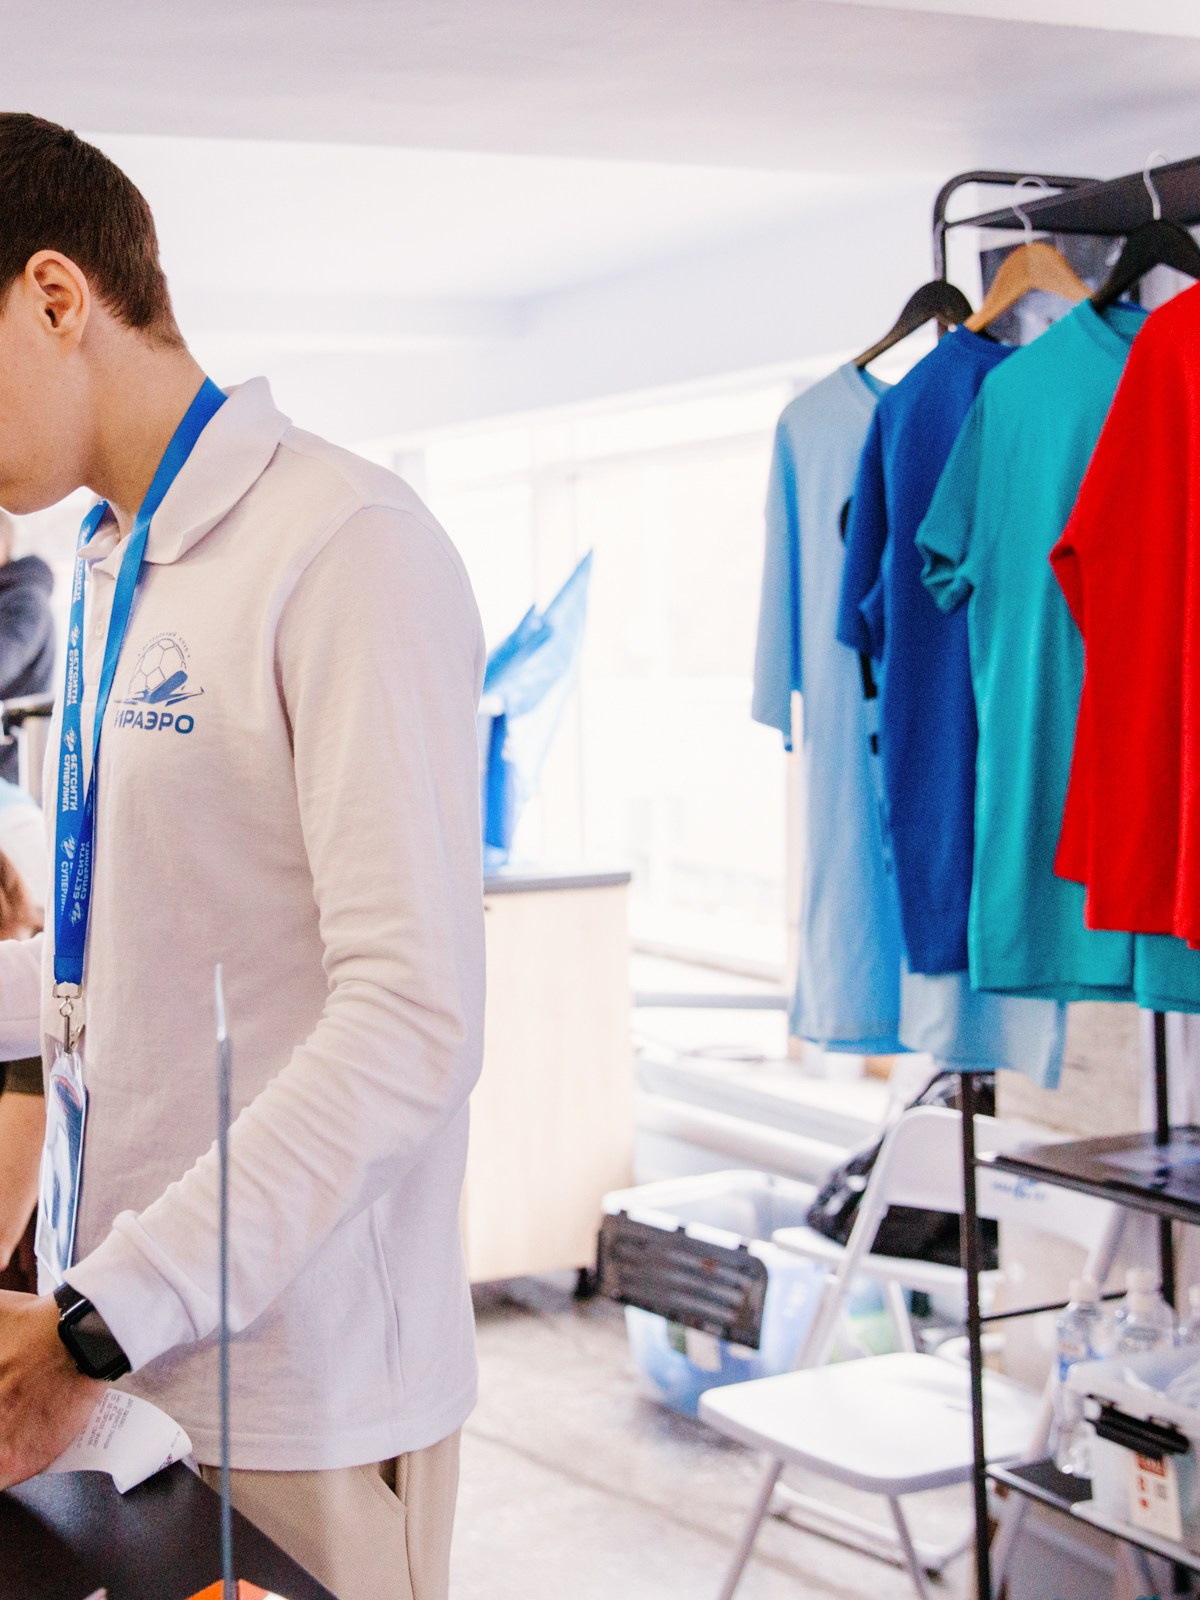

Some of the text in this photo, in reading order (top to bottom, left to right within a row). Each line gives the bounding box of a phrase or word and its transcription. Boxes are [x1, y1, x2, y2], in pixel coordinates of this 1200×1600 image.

[114, 710, 194, 734] ИРАЭРО
[62, 754, 70, 812] СУПЕРЛИГА
[70, 753, 78, 810] БЕТСИТИ
[73, 843, 86, 900] БЕТСИТИ
[80, 841, 90, 900] СУПЕРЛИГА
